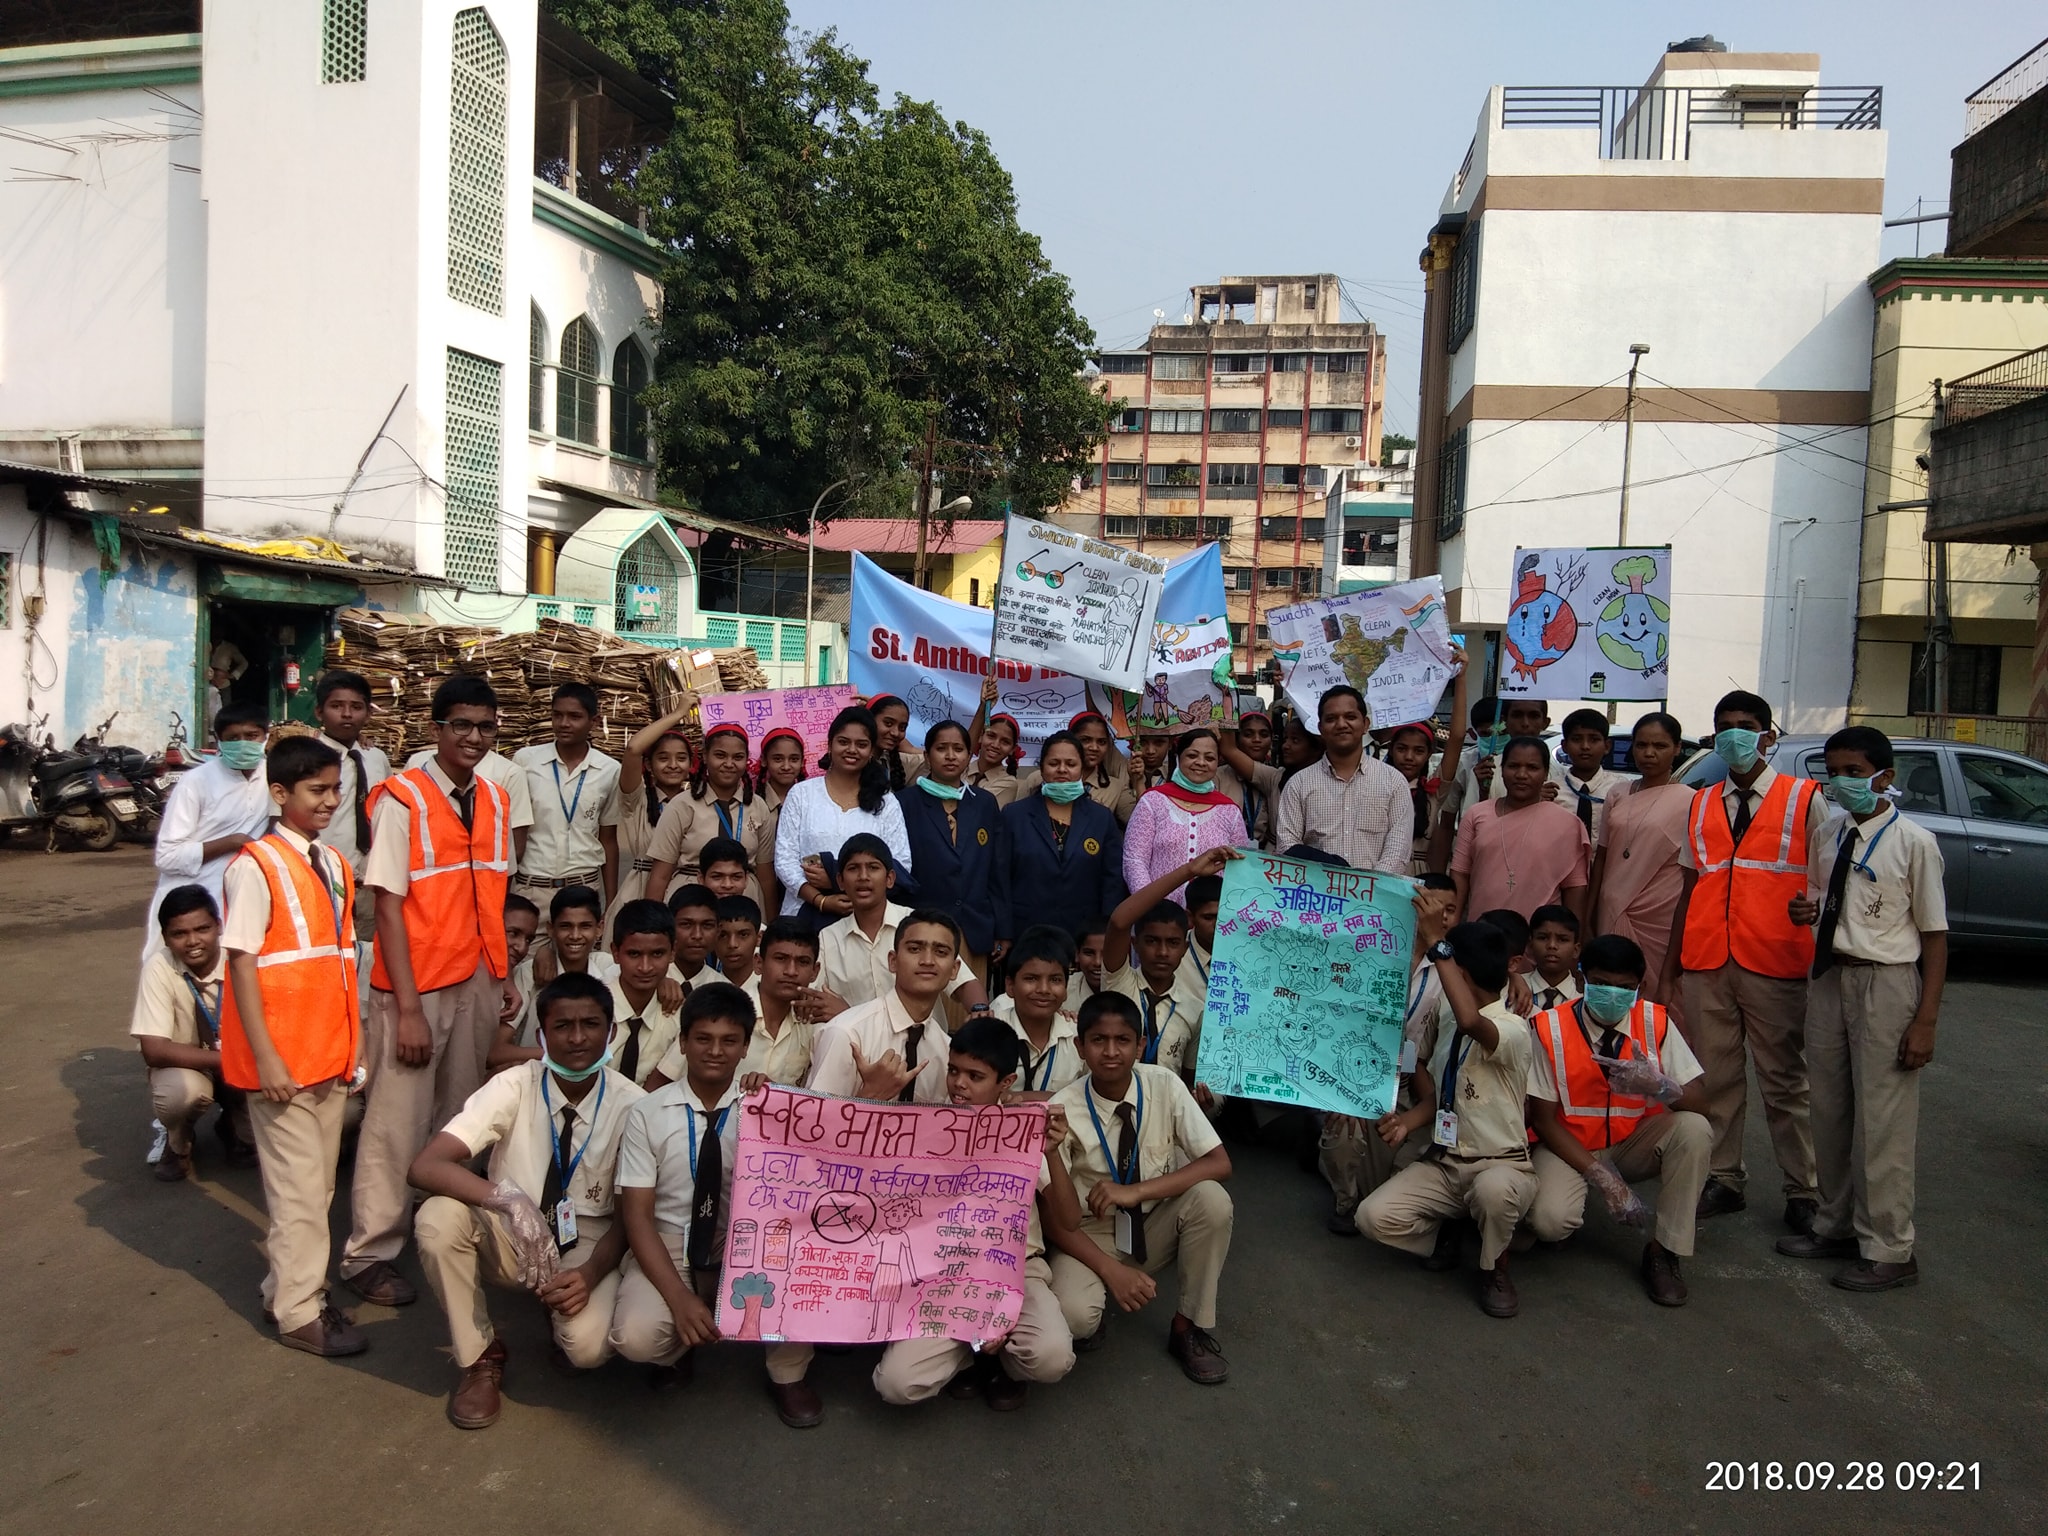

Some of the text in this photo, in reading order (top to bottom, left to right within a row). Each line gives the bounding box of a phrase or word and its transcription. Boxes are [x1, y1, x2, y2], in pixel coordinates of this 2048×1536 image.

[1593, 586, 1611, 605] CLEAN
[1268, 603, 1315, 625] Swachh
[1364, 620, 1391, 632] CLEAN
[871, 627, 1033, 682] St. Anthony
[1324, 675, 1342, 686] NEW
[1372, 673, 1406, 688] INDIA
[1024, 721, 1048, 729] भारत
[1322, 869, 1379, 902] भारत
[1273, 884, 1350, 915] अभियान
[1322, 921, 1338, 938] हम
[1344, 914, 1365, 934] सब
[1367, 914, 1383, 929] का
[1355, 932, 1377, 953] हाथ
[1208, 1000, 1230, 1012] भारत
[836, 1104, 921, 1157] भारत
[926, 1104, 1046, 1156] अभियान
[814, 1159, 864, 1193] आपण
[938, 1201, 971, 1223] नाही
[1003, 1209, 1027, 1232] नाही
[861, 1254, 876, 1267] या
[927, 1279, 961, 1299] नको
